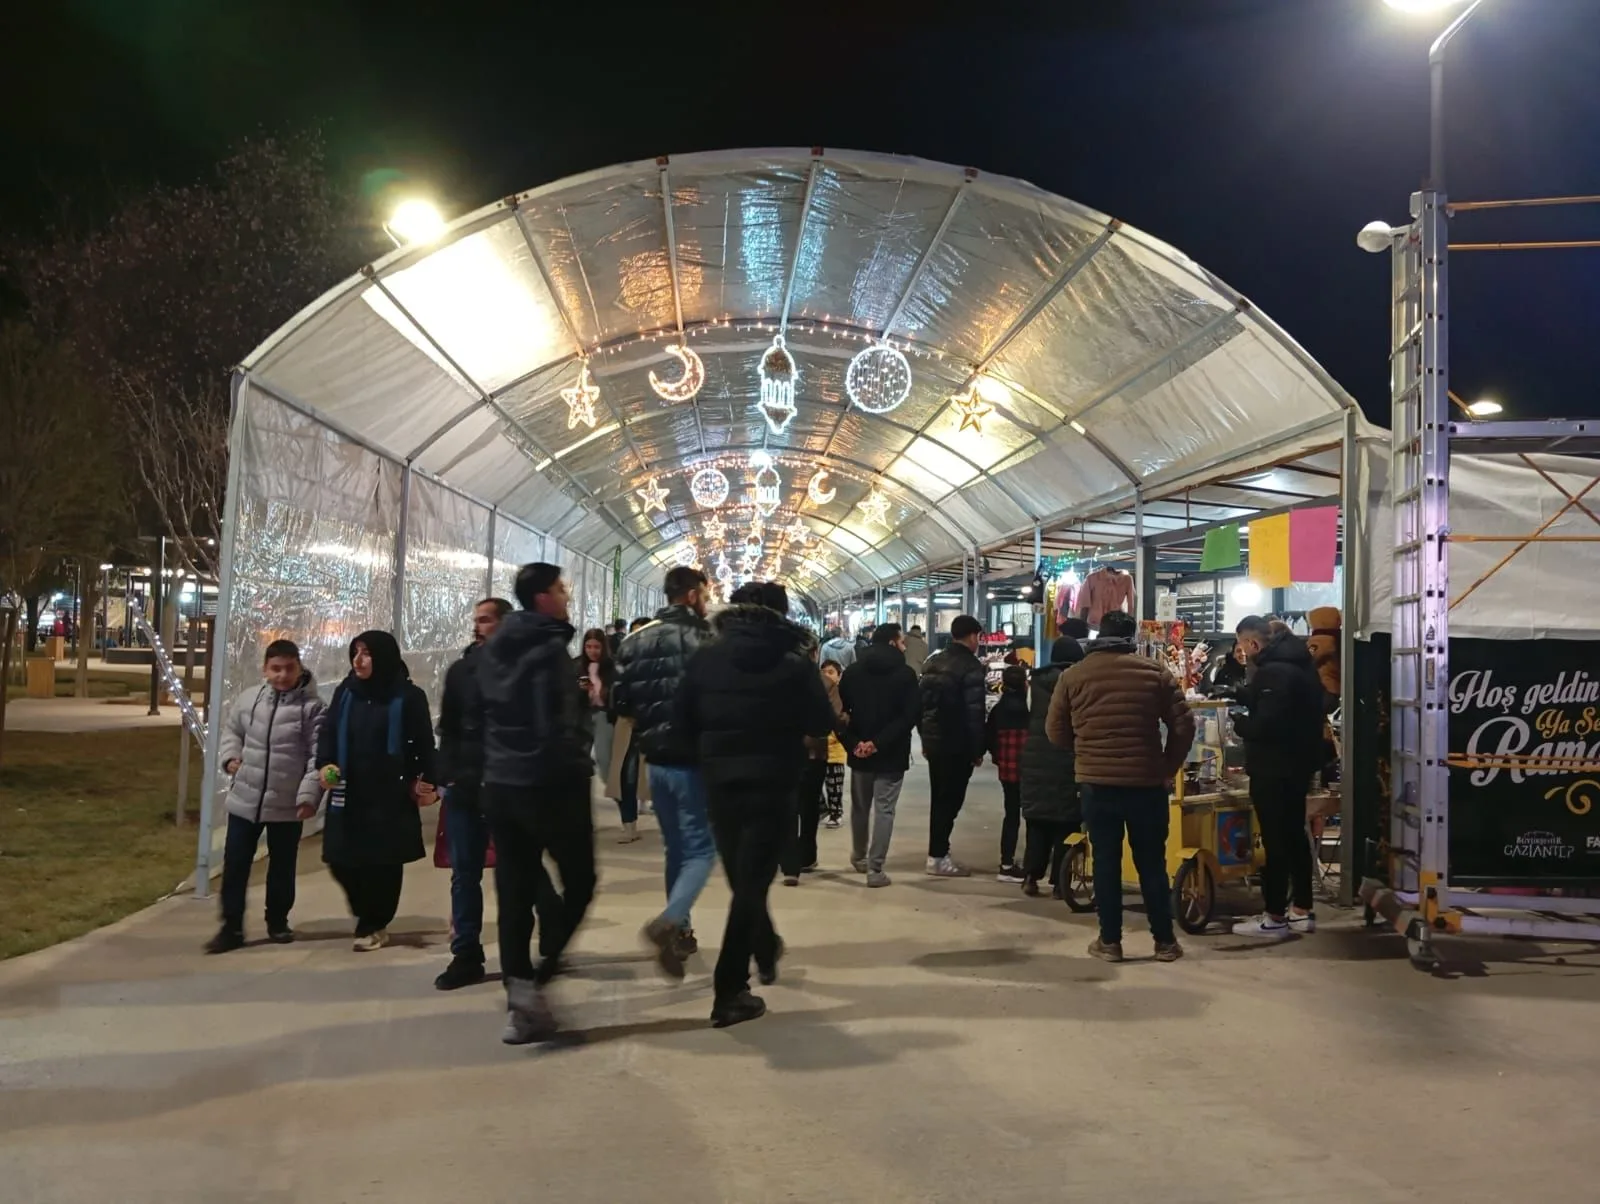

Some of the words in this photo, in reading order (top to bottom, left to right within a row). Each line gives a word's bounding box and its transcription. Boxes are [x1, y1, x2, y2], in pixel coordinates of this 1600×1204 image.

[1448, 670, 1517, 714] Hoş
[1521, 671, 1600, 714] geldin
[1535, 709, 1570, 739] Ya
